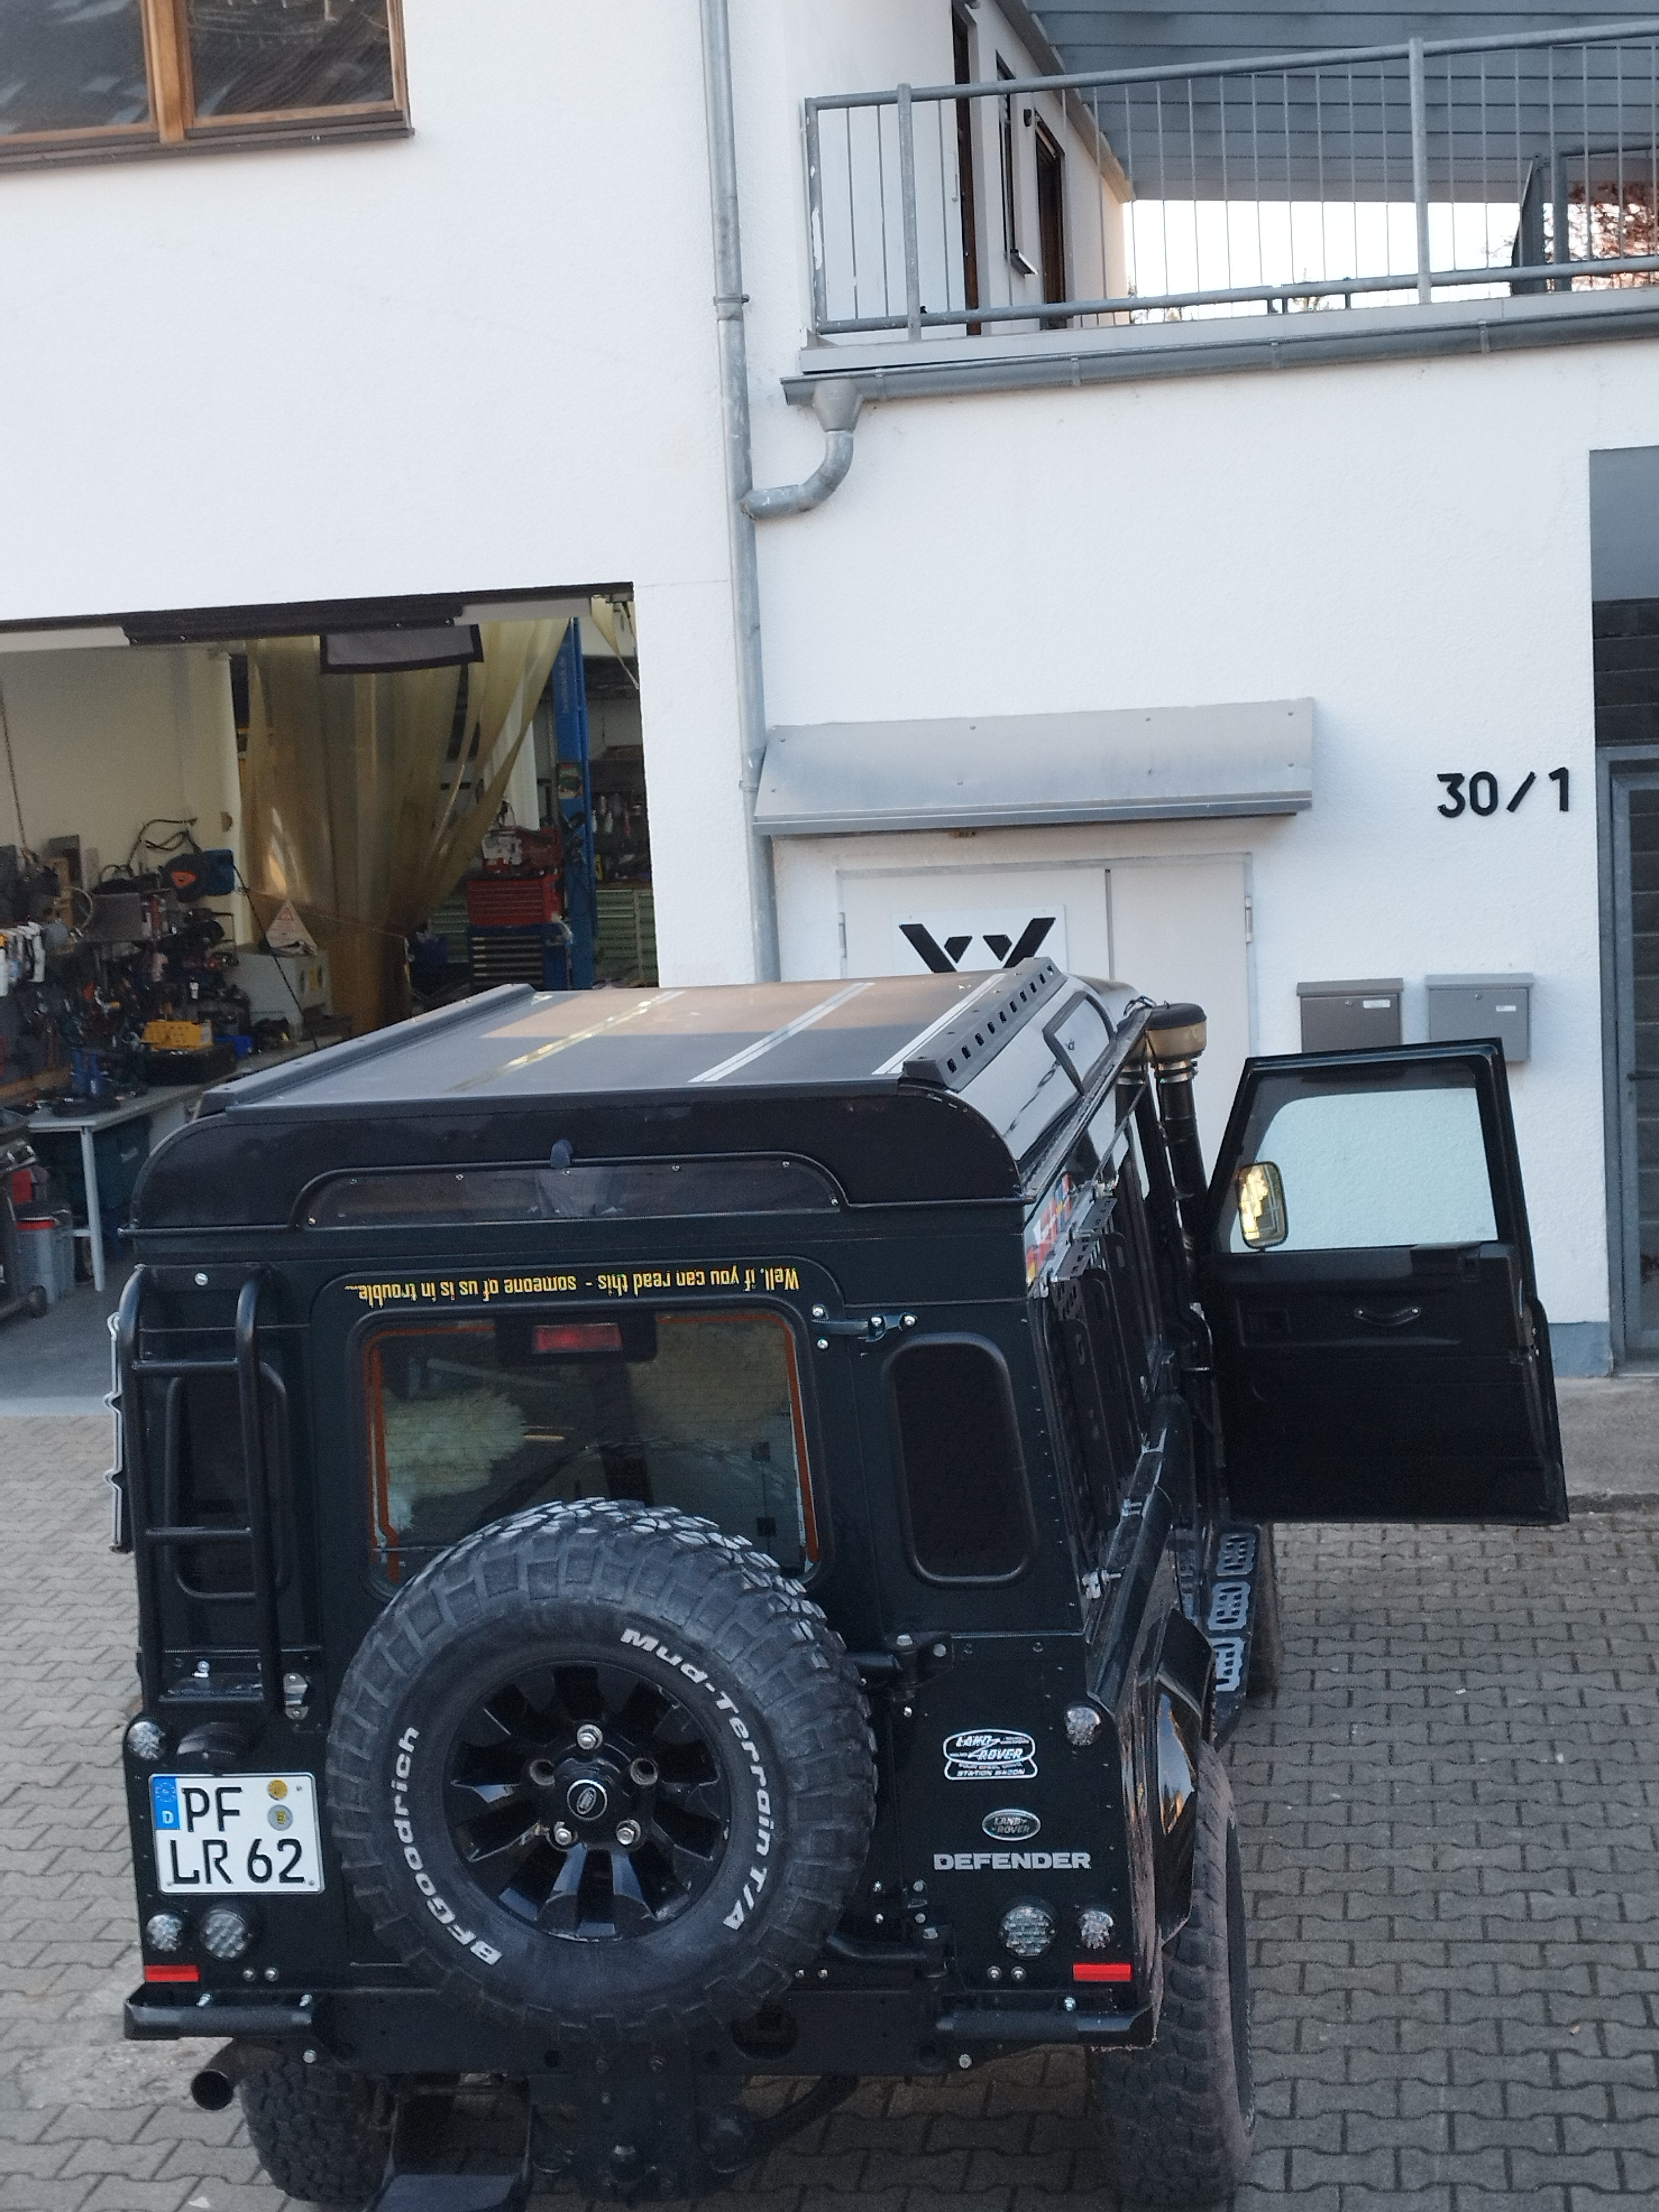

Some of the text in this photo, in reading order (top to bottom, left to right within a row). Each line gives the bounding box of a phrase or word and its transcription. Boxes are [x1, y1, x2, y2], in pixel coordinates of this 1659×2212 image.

[1436, 766, 1569, 818] 30/1
[633, 1271, 671, 1296] read
[676, 1269, 706, 1286] can
[710, 1264, 739, 1286] you
[743, 1269, 756, 1292] if
[421, 1282, 436, 1302] in
[440, 1281, 455, 1301] is
[459, 1280, 479, 1296] us
[482, 1279, 499, 1302] of
[503, 1276, 577, 1295] someone
[597, 1274, 628, 1297] this
[956, 1735, 994, 1747] LAND
[977, 1748, 1024, 1760] ROVER
[620, 1628, 774, 1931] Mud-Terrain T/A
[162, 1811, 174, 1824] D
[181, 1787, 242, 1832] PF
[994, 1817, 1021, 1825] LAND
[997, 1825, 1030, 1834] ROVER
[390, 1727, 503, 1965] BFGoodrich
[170, 1838, 306, 1884] LR 62
[933, 1852, 1092, 1870] DEFENDER
